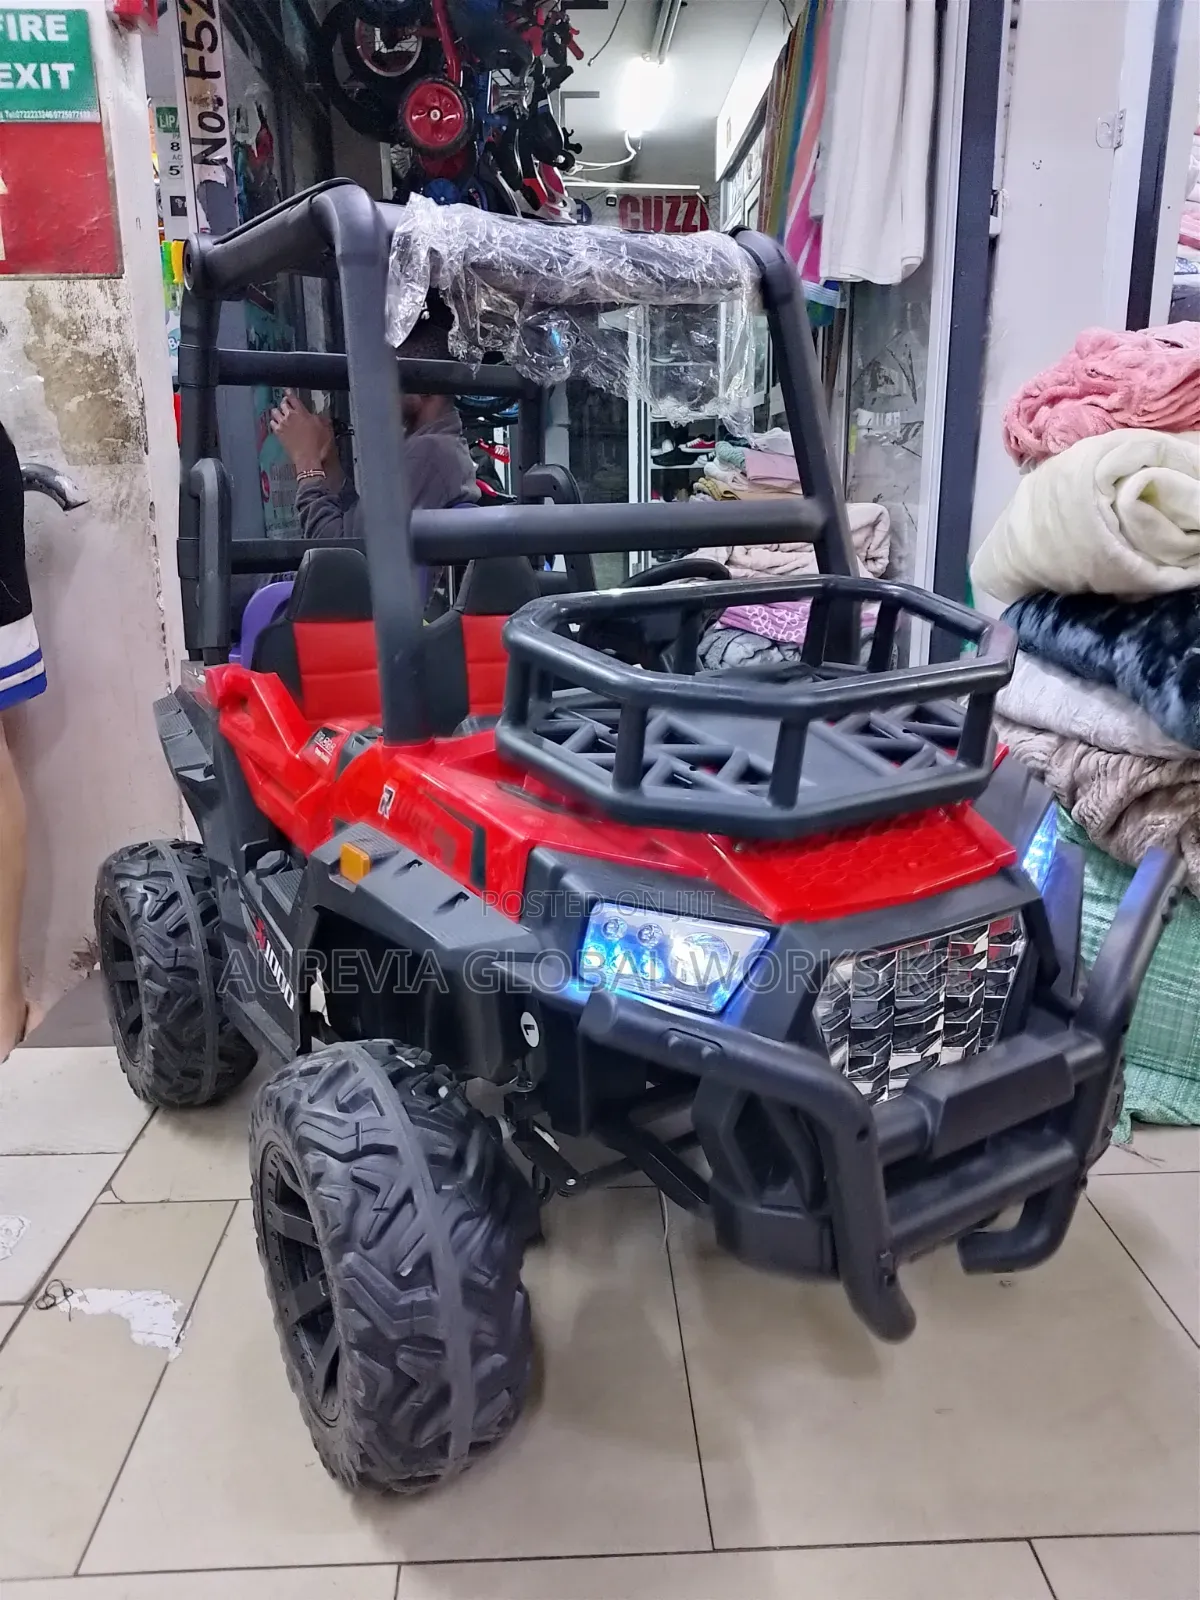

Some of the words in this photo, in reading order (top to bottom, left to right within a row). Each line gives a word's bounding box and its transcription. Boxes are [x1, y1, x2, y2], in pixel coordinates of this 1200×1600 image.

[0, 14, 69, 42] IRE
[0, 63, 75, 90] EXIT
[190, 95, 229, 166] No.
